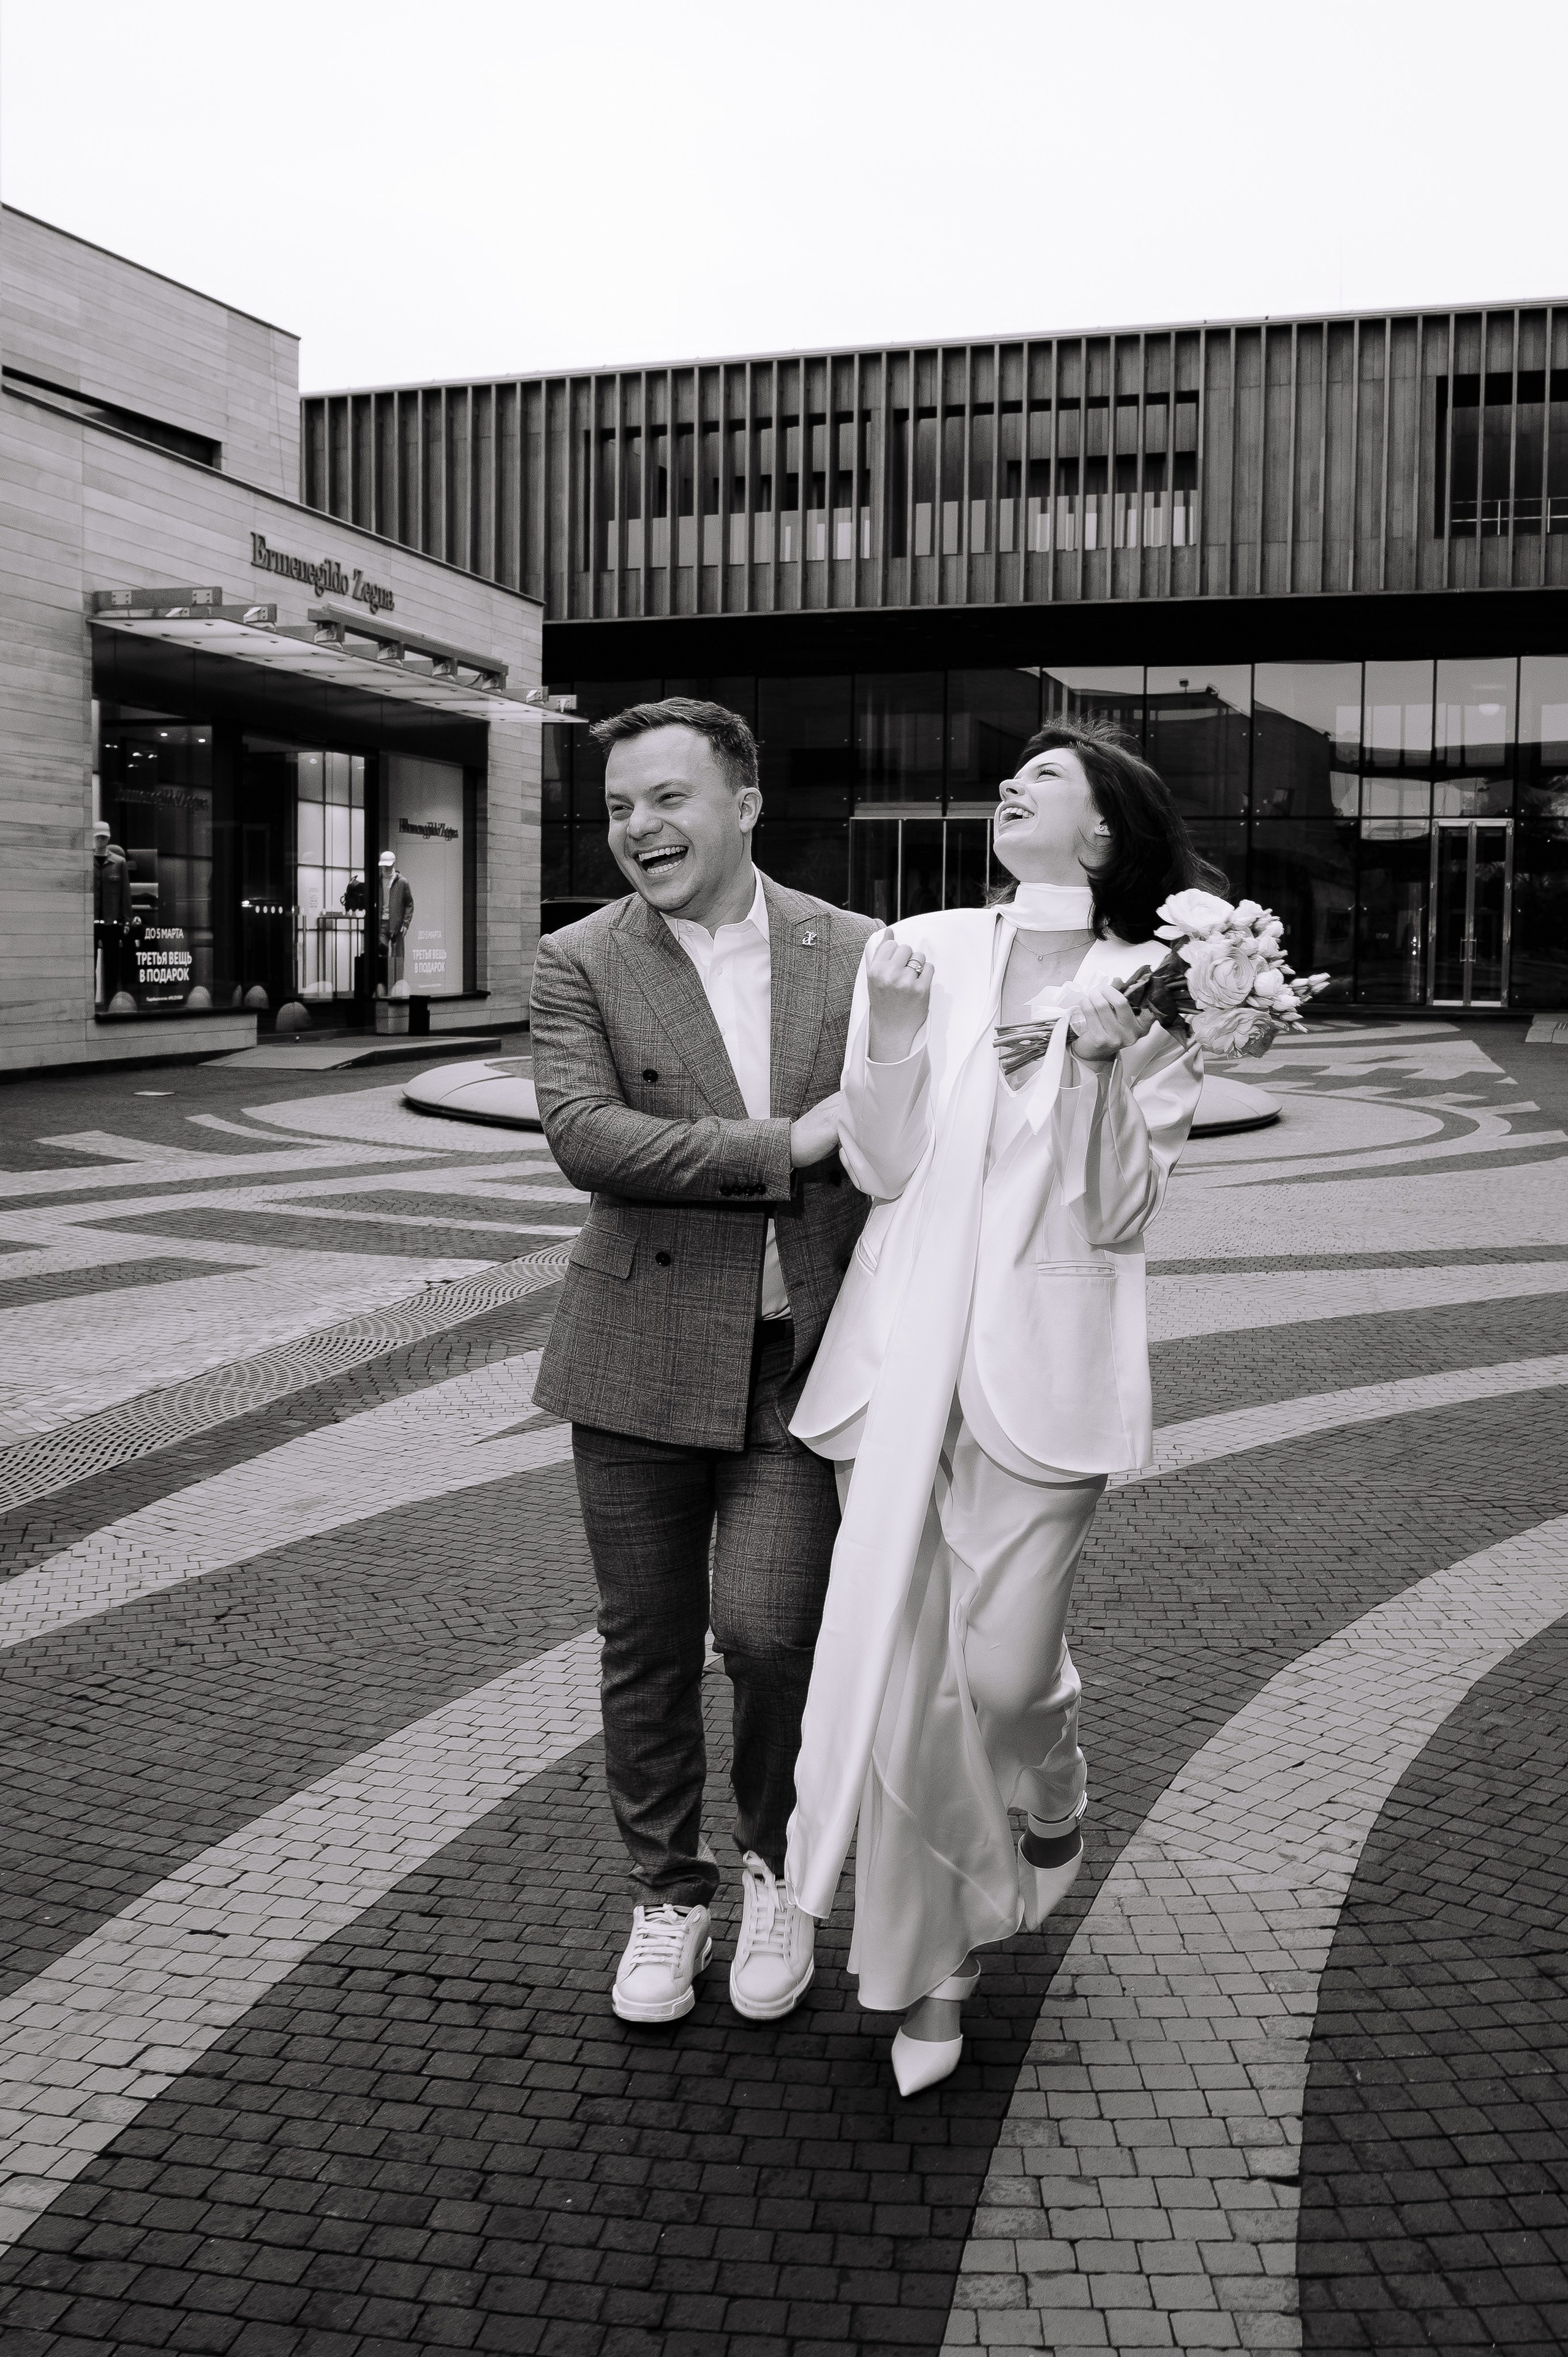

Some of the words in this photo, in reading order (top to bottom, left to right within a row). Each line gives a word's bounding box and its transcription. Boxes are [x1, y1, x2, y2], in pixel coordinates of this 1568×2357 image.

[251, 532, 349, 597] Ermenegildo
[353, 568, 394, 614] Zegna
[145, 928, 156, 940] ДО
[156, 928, 160, 938] 5
[161, 928, 184, 938] МАРТА
[135, 951, 167, 965] ТРЕТЬЯ
[168, 951, 192, 966] ВЕЩЬ
[140, 969, 145, 982] В
[146, 968, 190, 984] ПОДАРОК
